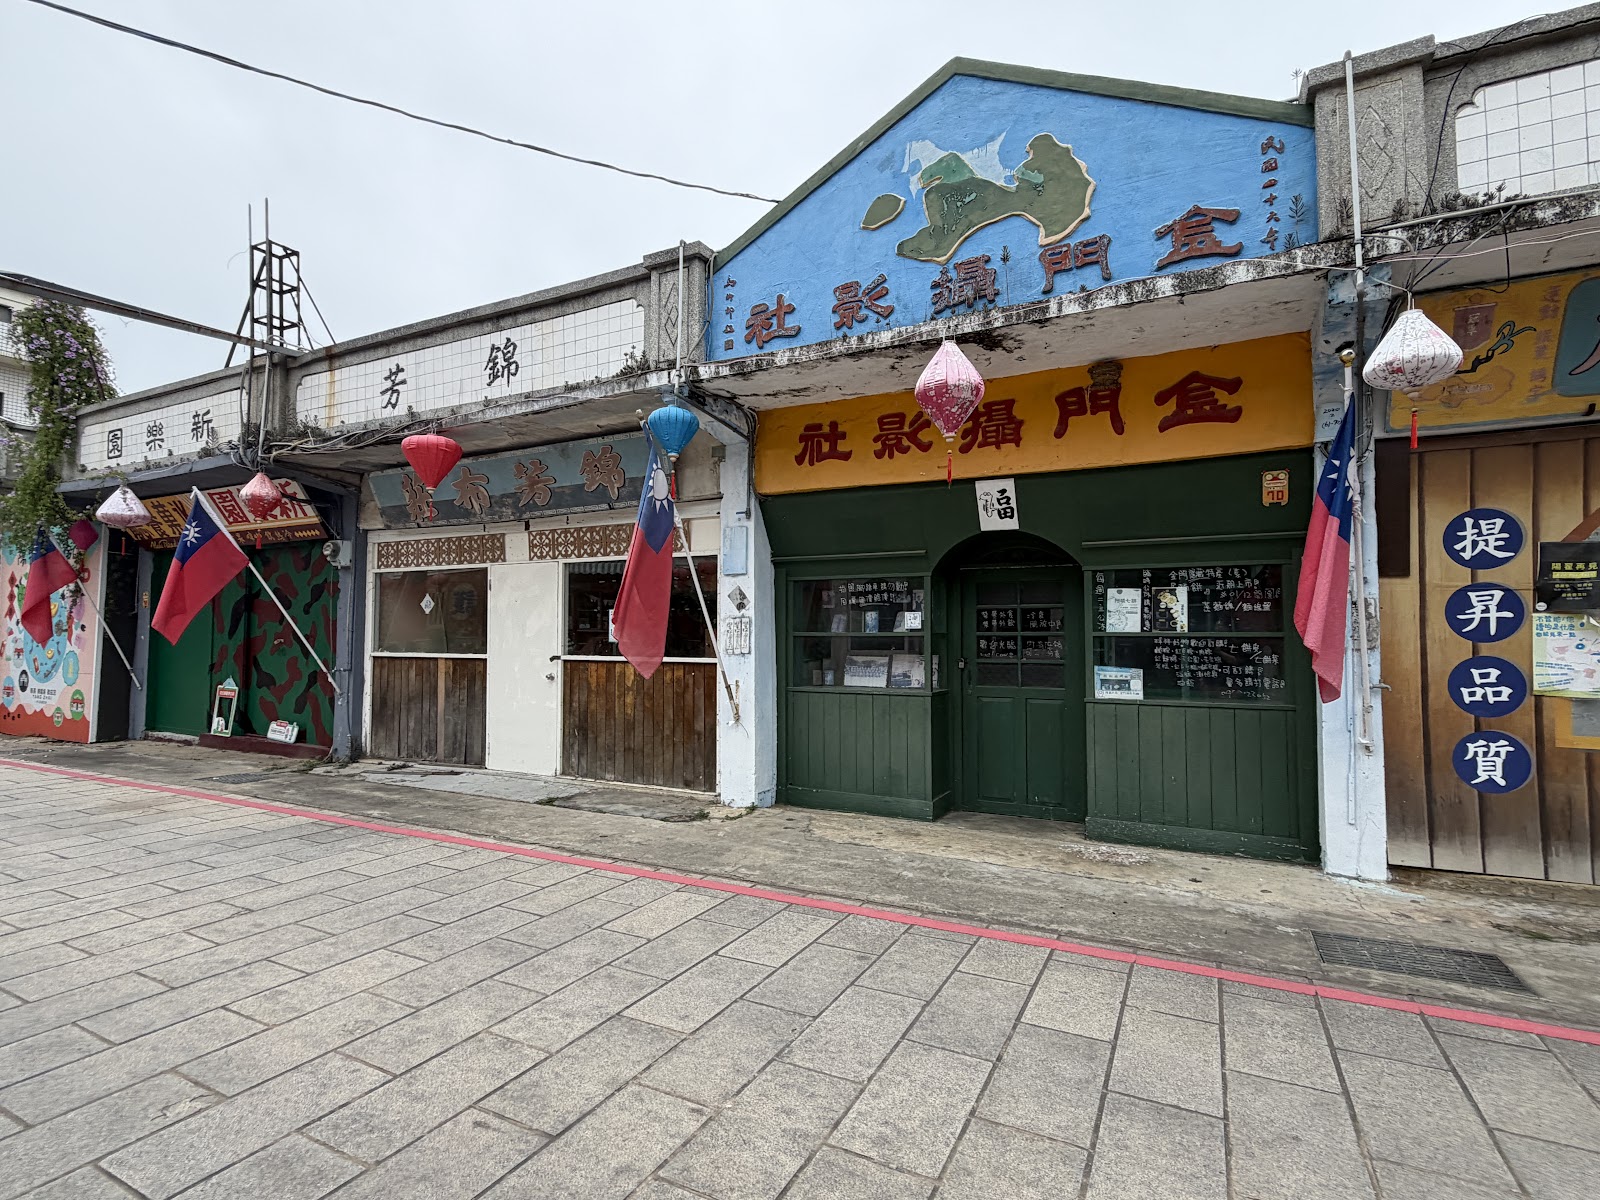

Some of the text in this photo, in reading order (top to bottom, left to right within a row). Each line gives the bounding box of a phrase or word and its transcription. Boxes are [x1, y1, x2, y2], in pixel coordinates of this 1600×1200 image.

[1267, 490, 1284, 501] 70
[1453, 516, 1515, 786] 提昇品質
